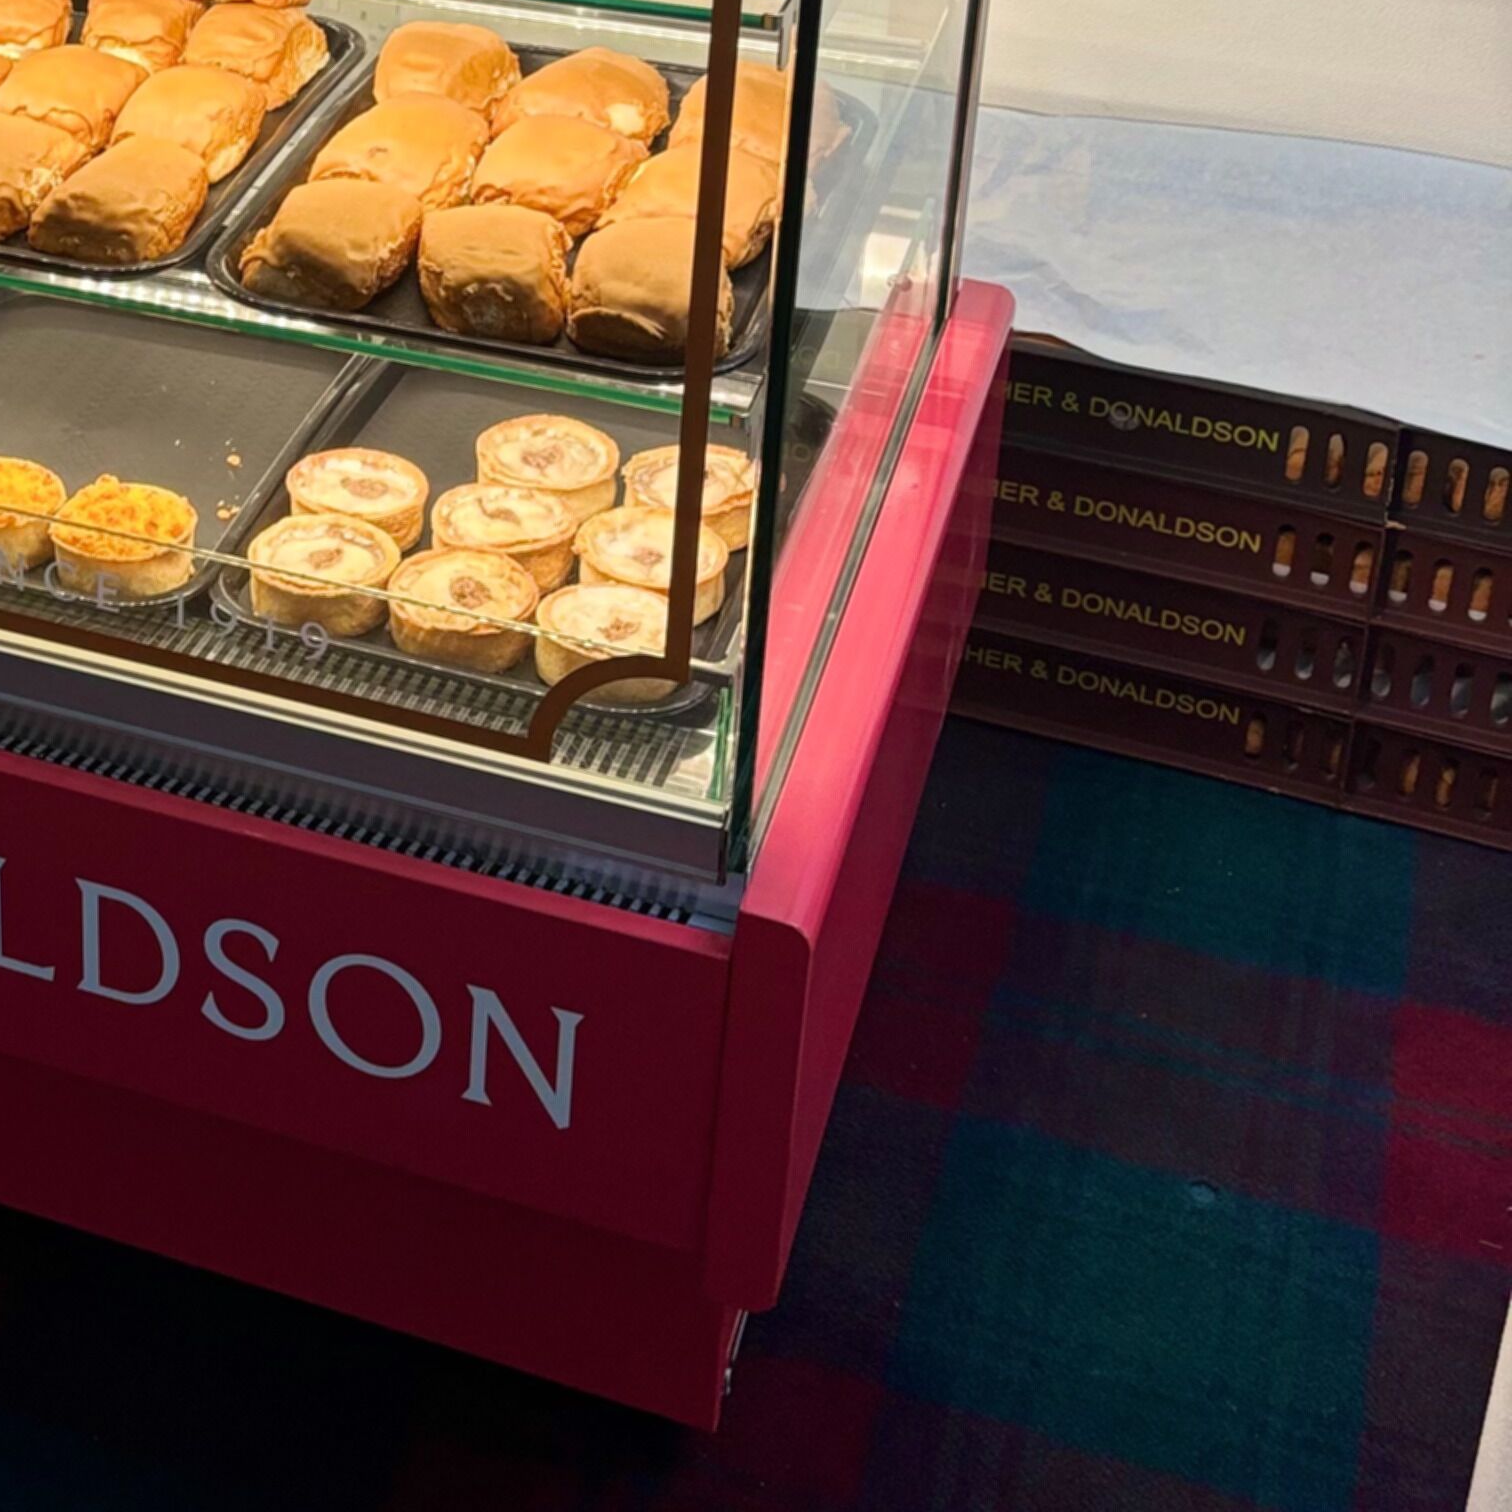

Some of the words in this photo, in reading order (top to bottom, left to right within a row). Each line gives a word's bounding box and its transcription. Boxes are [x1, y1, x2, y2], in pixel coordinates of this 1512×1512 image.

[1061, 391, 1080, 413] &
[1089, 396, 1281, 452] DONALDSON
[1047, 491, 1065, 512] &
[1073, 496, 1262, 554] DONALDSON
[171, 586, 330, 662] 1919
[1034, 583, 1053, 604] &
[1061, 588, 1246, 646] DONALDSON
[1030, 659, 1048, 681] &
[1057, 666, 1241, 726] DONALDSON
